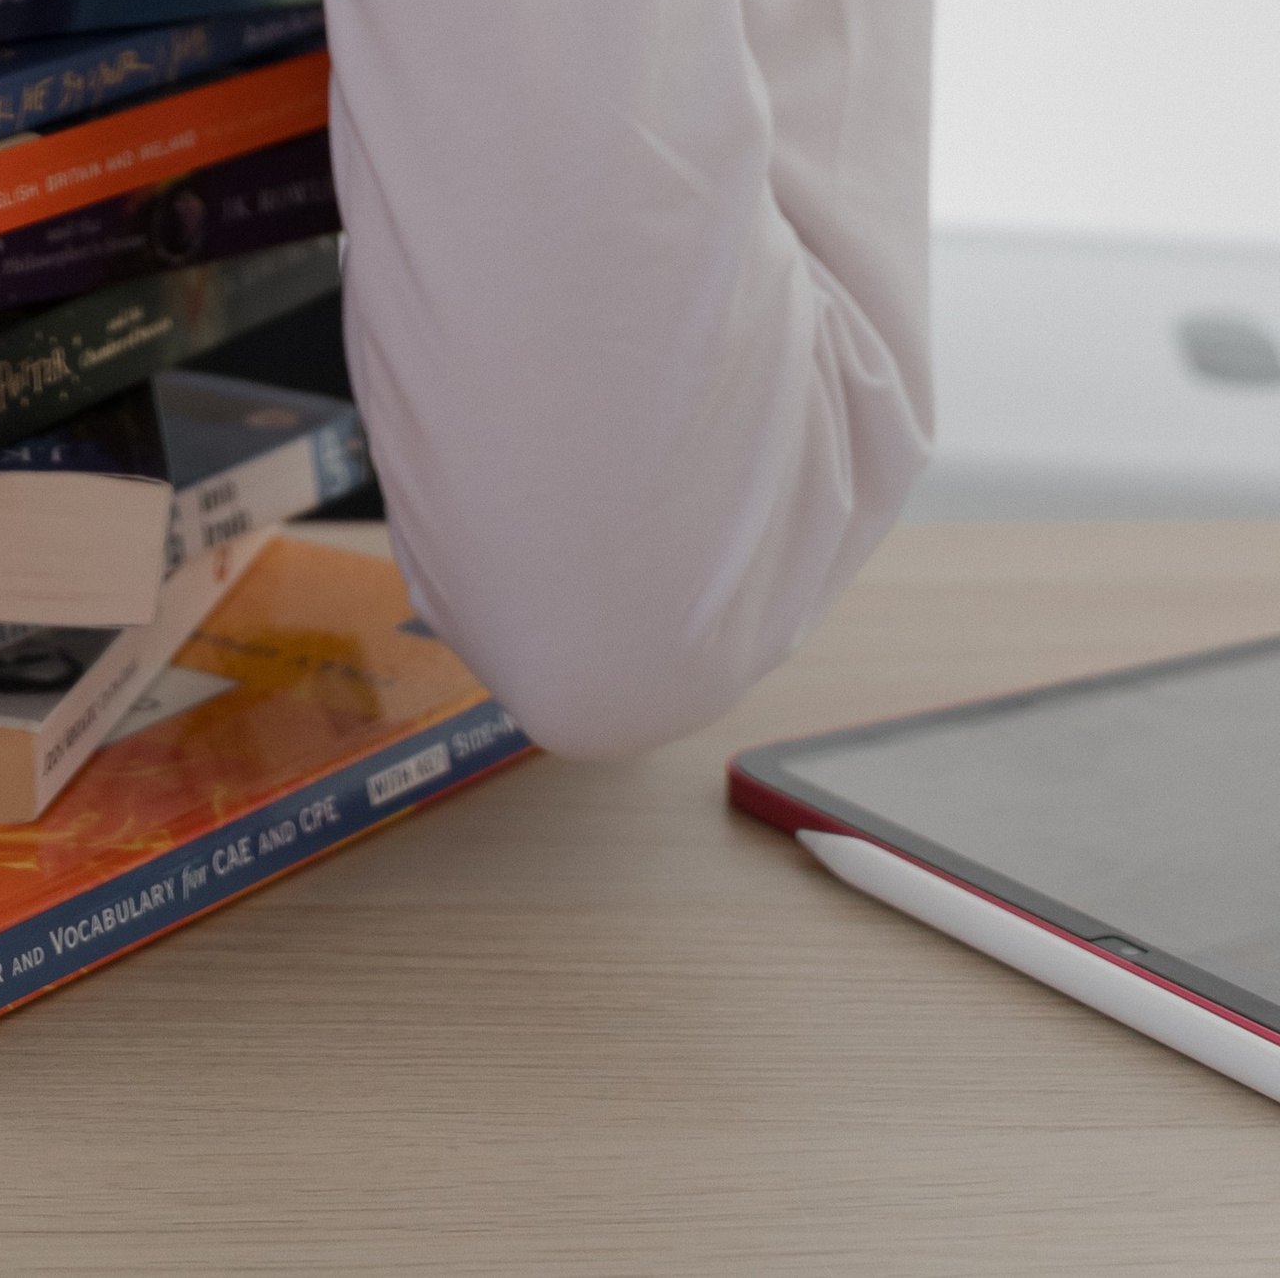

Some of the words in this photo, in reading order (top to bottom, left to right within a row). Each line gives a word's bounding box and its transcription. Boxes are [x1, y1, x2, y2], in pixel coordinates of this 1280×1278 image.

[44, 161, 103, 195] BRITAIN
[11, 946, 46, 977] AND
[49, 876, 177, 956] VOCABULARY
[182, 864, 210, 901] for
[211, 835, 255, 876] CAE
[258, 819, 298, 856] AND
[298, 794, 342, 835] CPE
